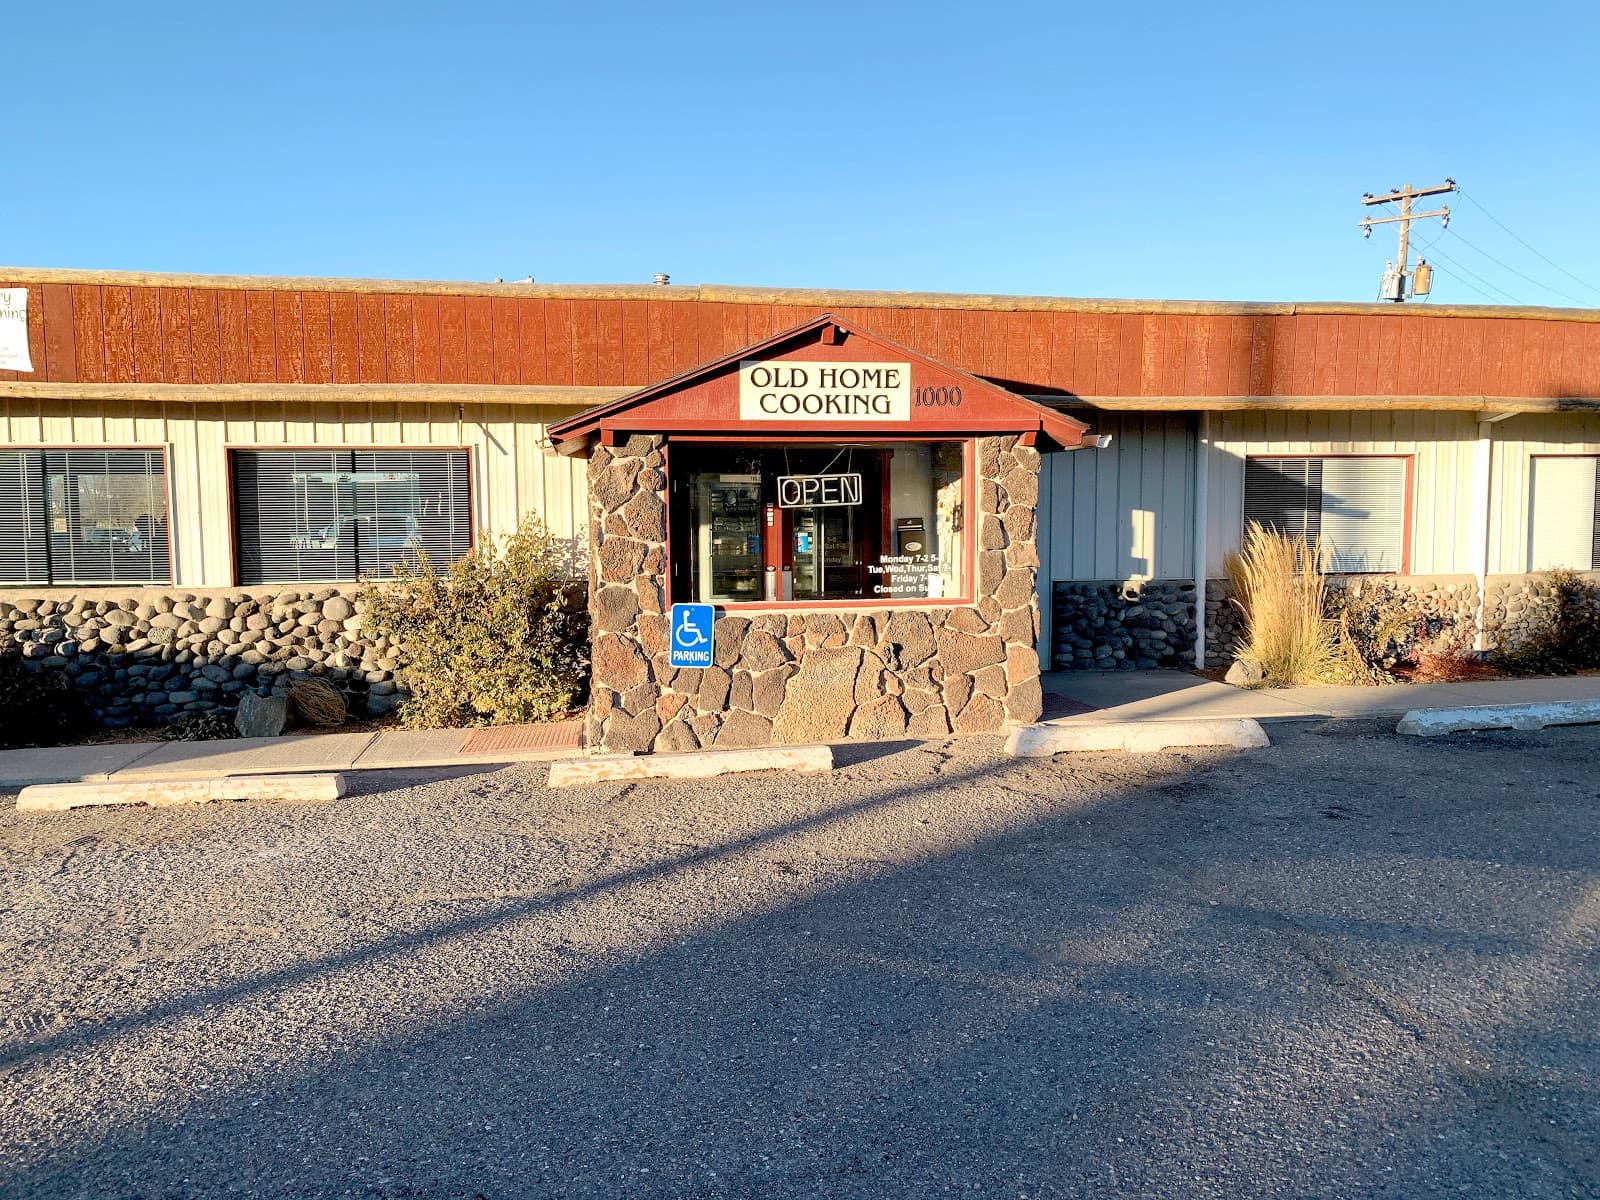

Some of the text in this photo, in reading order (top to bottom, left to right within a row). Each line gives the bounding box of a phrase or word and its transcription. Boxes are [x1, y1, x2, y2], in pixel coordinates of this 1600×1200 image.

[750, 367, 901, 389] OLD HOME
[759, 393, 891, 415] COOKING
[914, 386, 963, 407] 1000
[781, 477, 858, 505] OPEN
[880, 554, 914, 564] Monday
[915, 554, 929, 563] 7-2
[891, 574, 918, 584] Friday
[874, 584, 904, 593] Closed
[905, 585, 917, 593] on
[673, 650, 710, 662] PARKING
